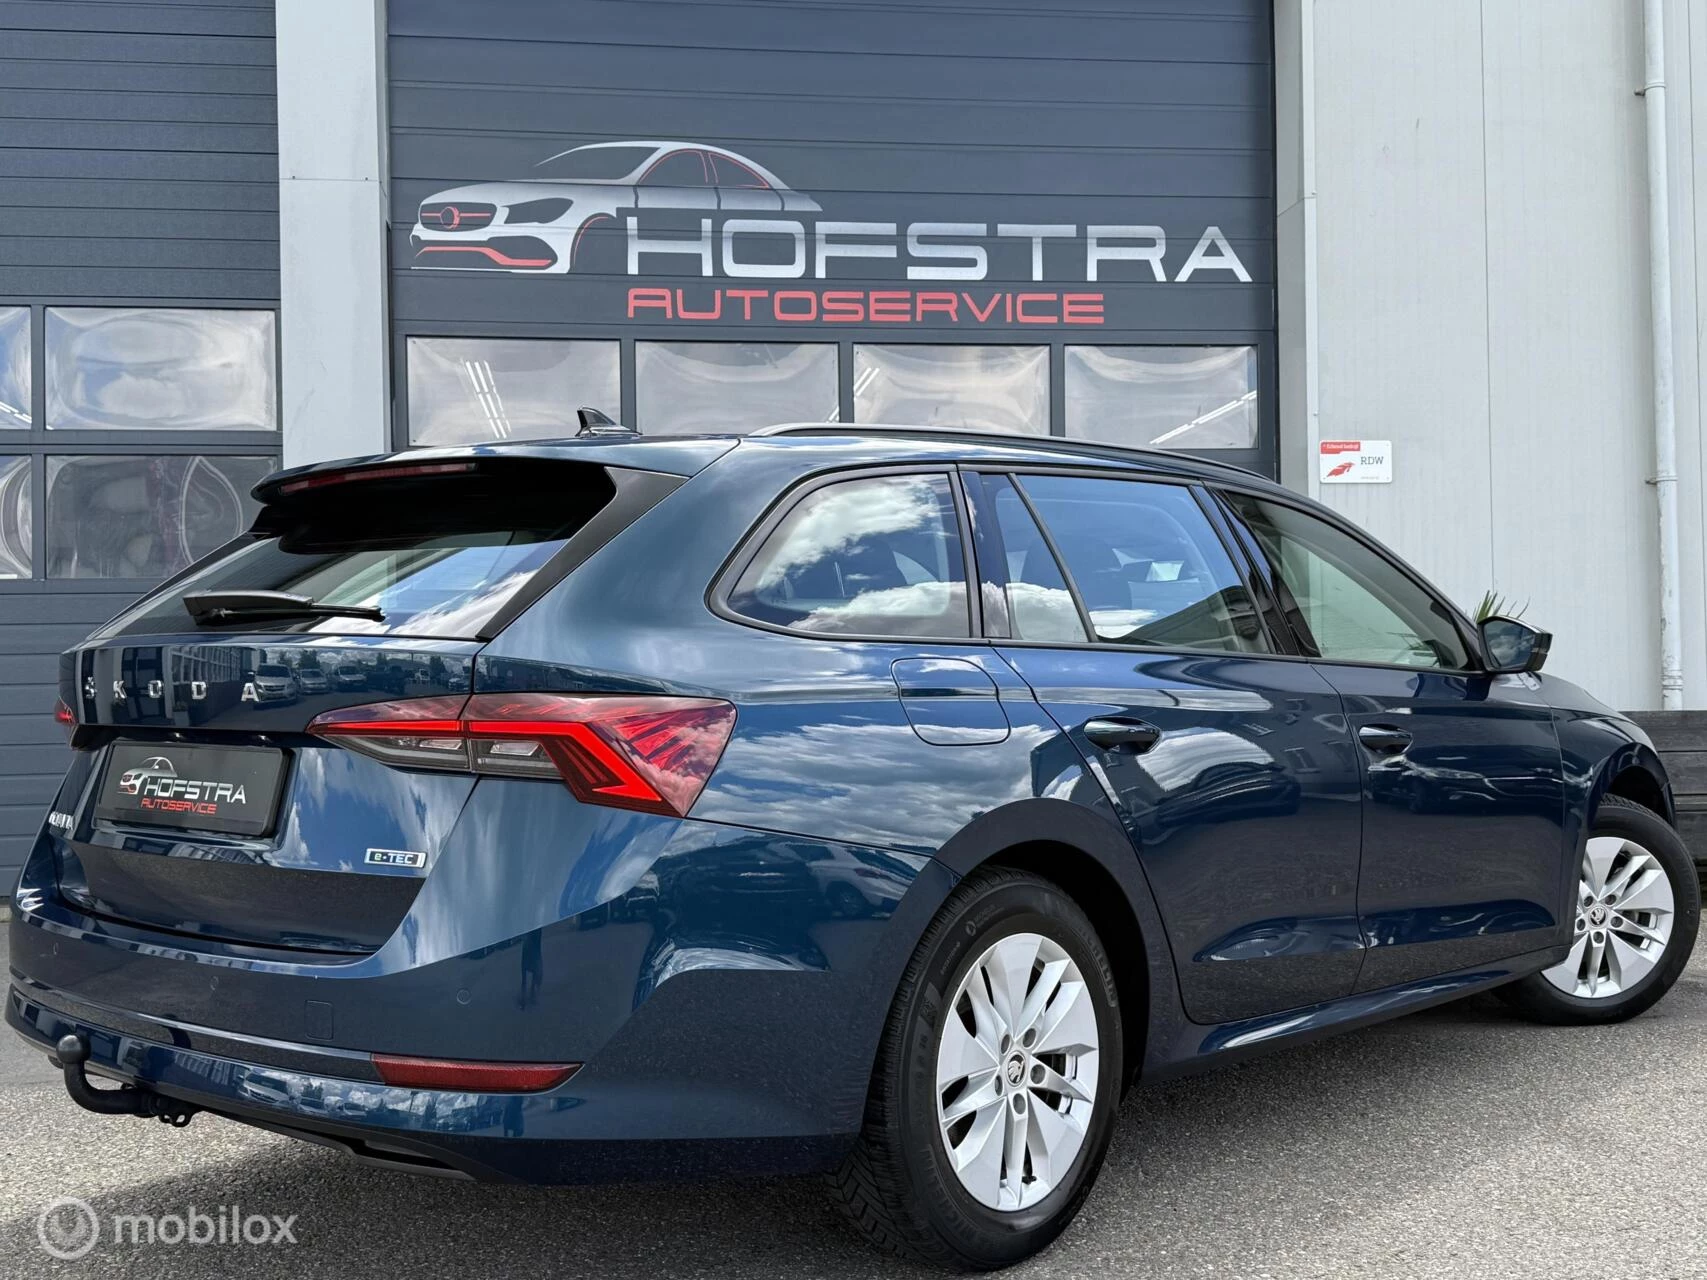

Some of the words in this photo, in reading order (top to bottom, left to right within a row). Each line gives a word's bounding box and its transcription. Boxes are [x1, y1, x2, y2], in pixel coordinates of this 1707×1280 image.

[626, 216, 1253, 283] HOFSTRA
[627, 288, 1105, 324] AUTOSERVICE
[1360, 456, 1384, 465] RDW
[143, 777, 247, 804] HOFSTRA
[140, 798, 218, 815] AUTOSERVICE
